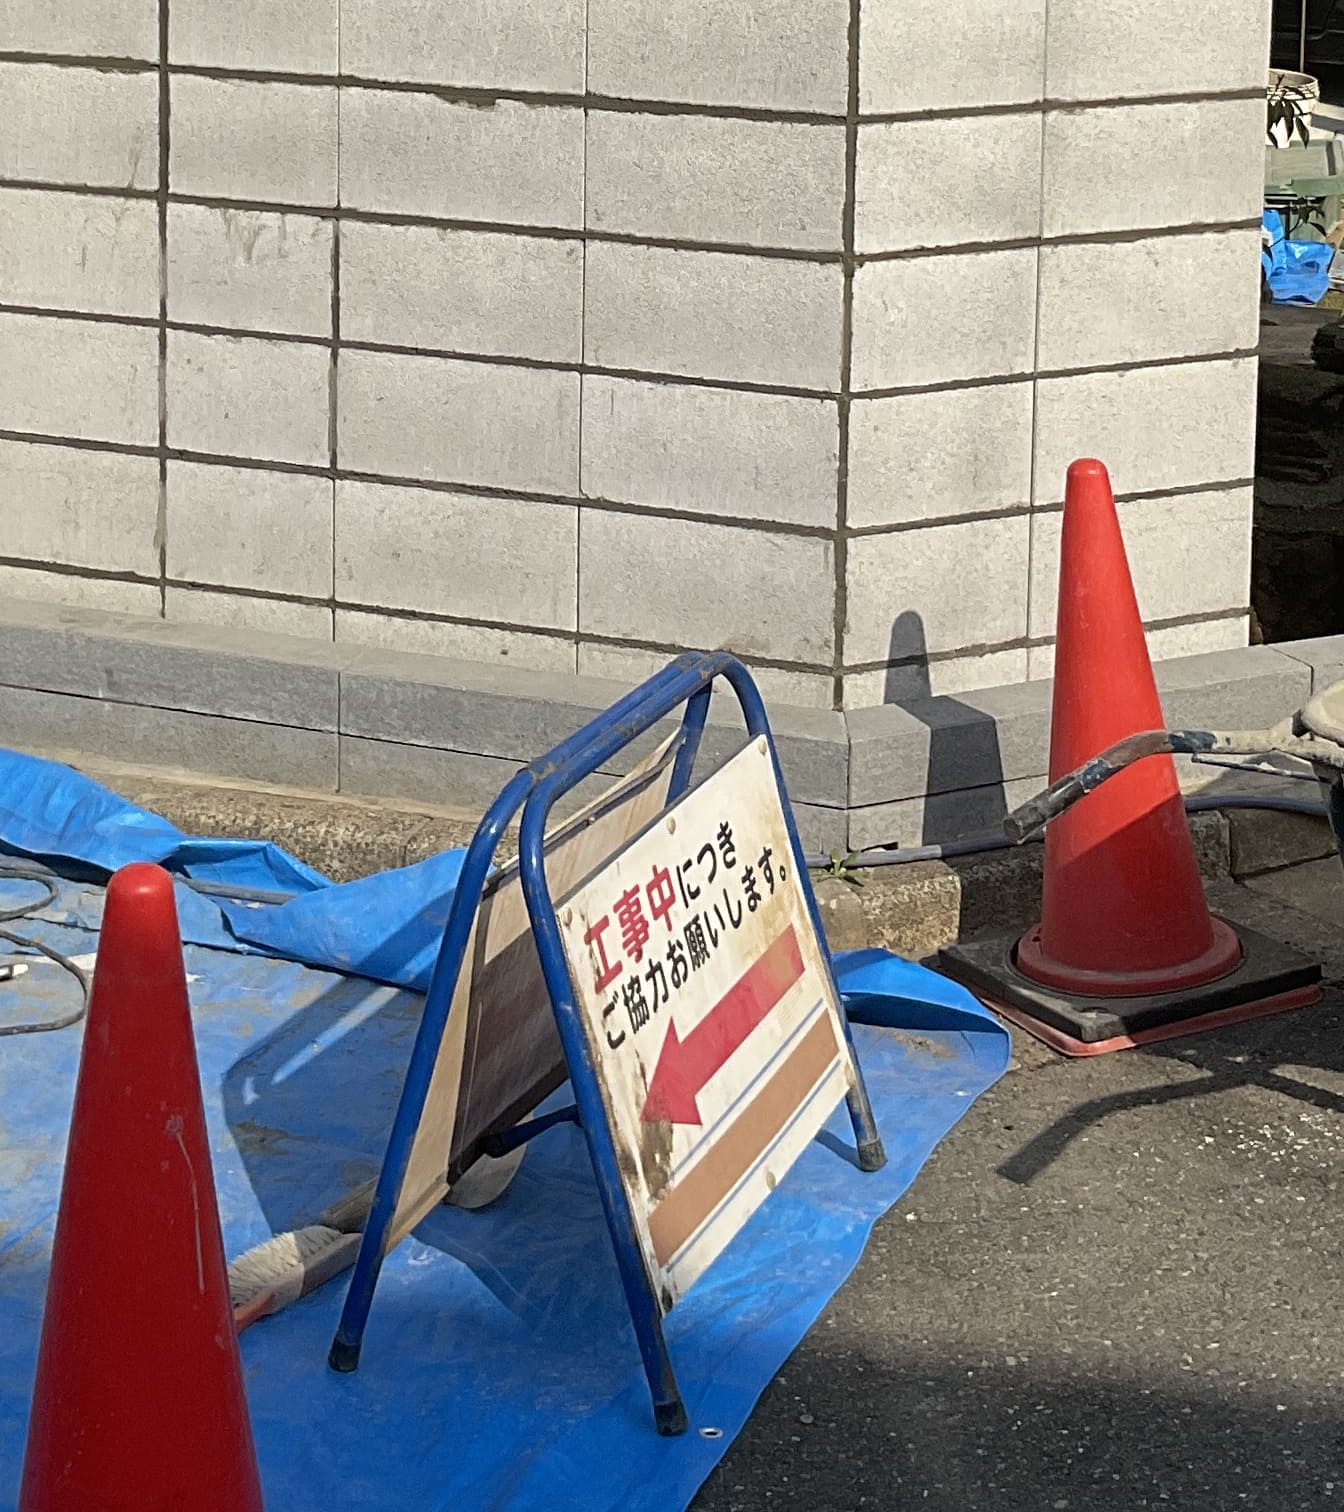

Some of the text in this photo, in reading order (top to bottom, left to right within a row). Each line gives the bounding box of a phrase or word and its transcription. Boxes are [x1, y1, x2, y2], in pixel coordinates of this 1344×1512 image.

[584, 821, 737, 995] 工事中につき
[602, 846, 787, 1050] ご協力お願いします。
